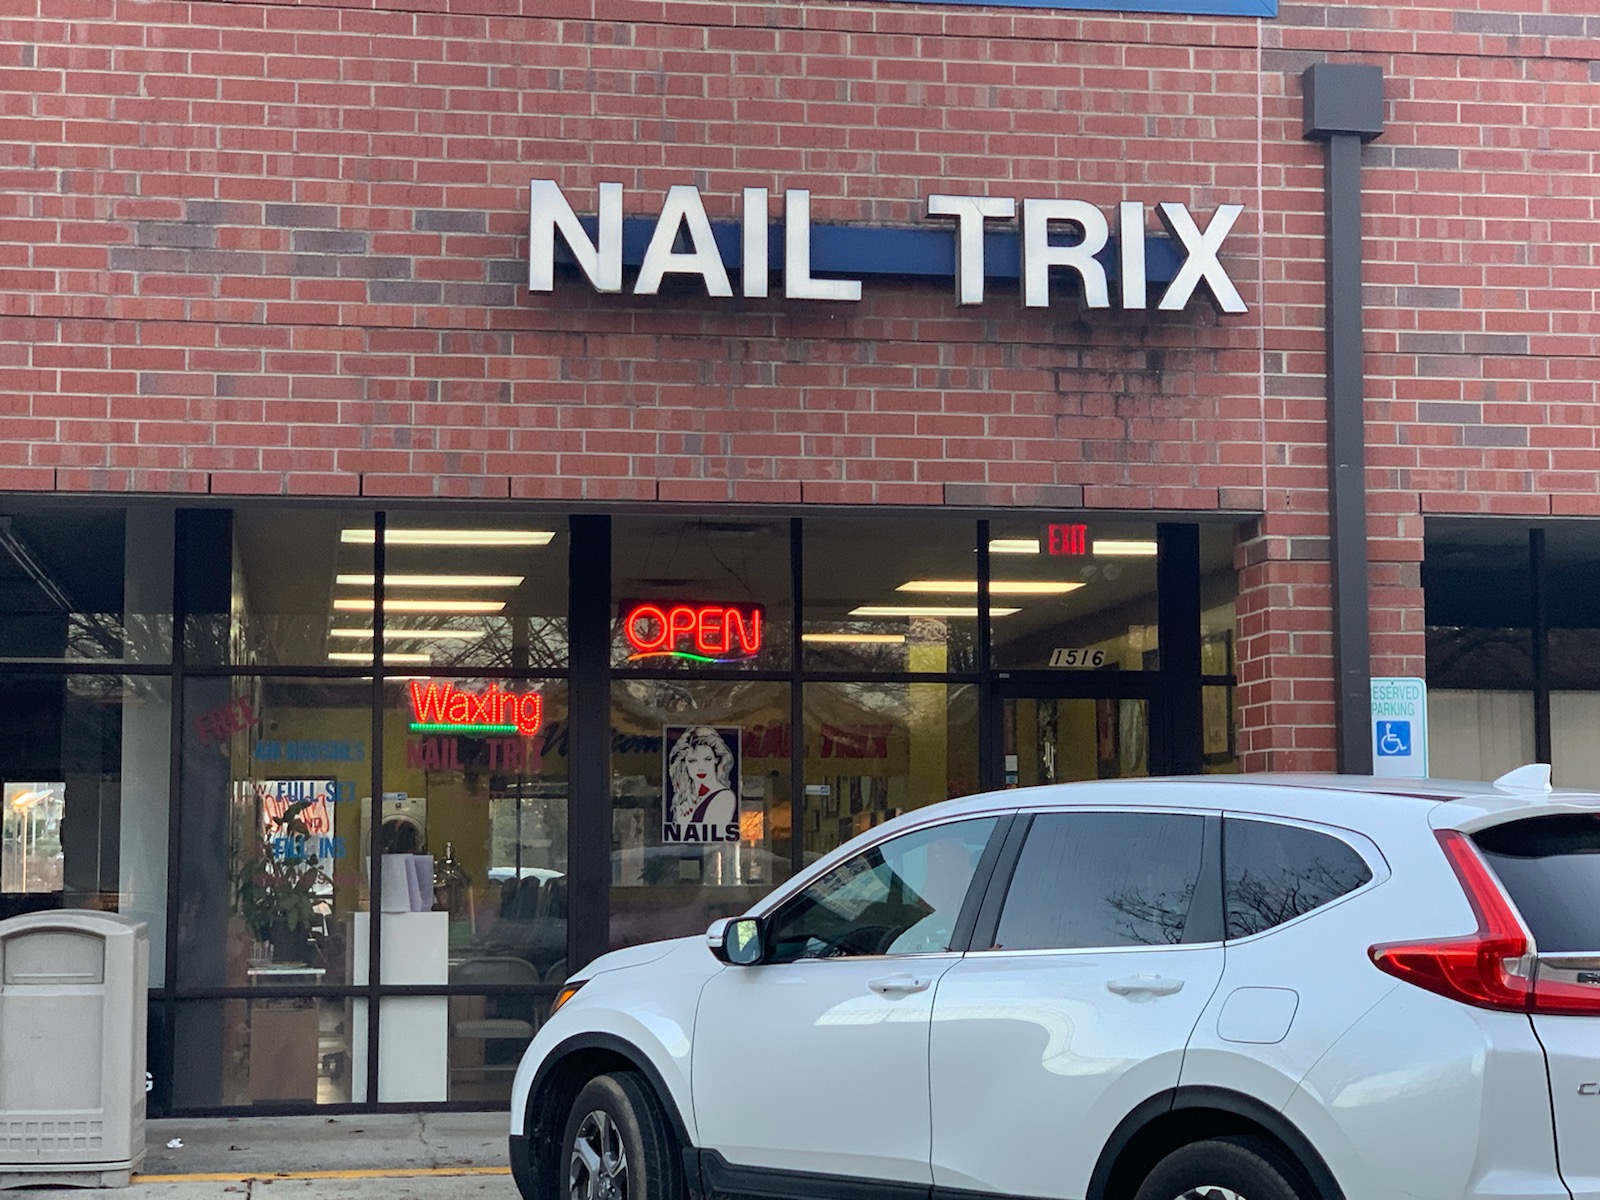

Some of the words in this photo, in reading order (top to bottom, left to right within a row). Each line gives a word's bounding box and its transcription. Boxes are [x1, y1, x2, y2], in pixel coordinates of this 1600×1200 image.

[528, 179, 862, 301] NAIL
[926, 194, 1249, 314] TRIX
[1048, 524, 1087, 555] EXIT
[625, 604, 761, 653] OPEN
[1054, 650, 1104, 666] 1516
[1372, 685, 1420, 700] ESERVED
[410, 682, 542, 735] Waxing
[406, 737, 465, 771] NAIL
[276, 781, 319, 803] FULL
[663, 824, 741, 842] NAILS
